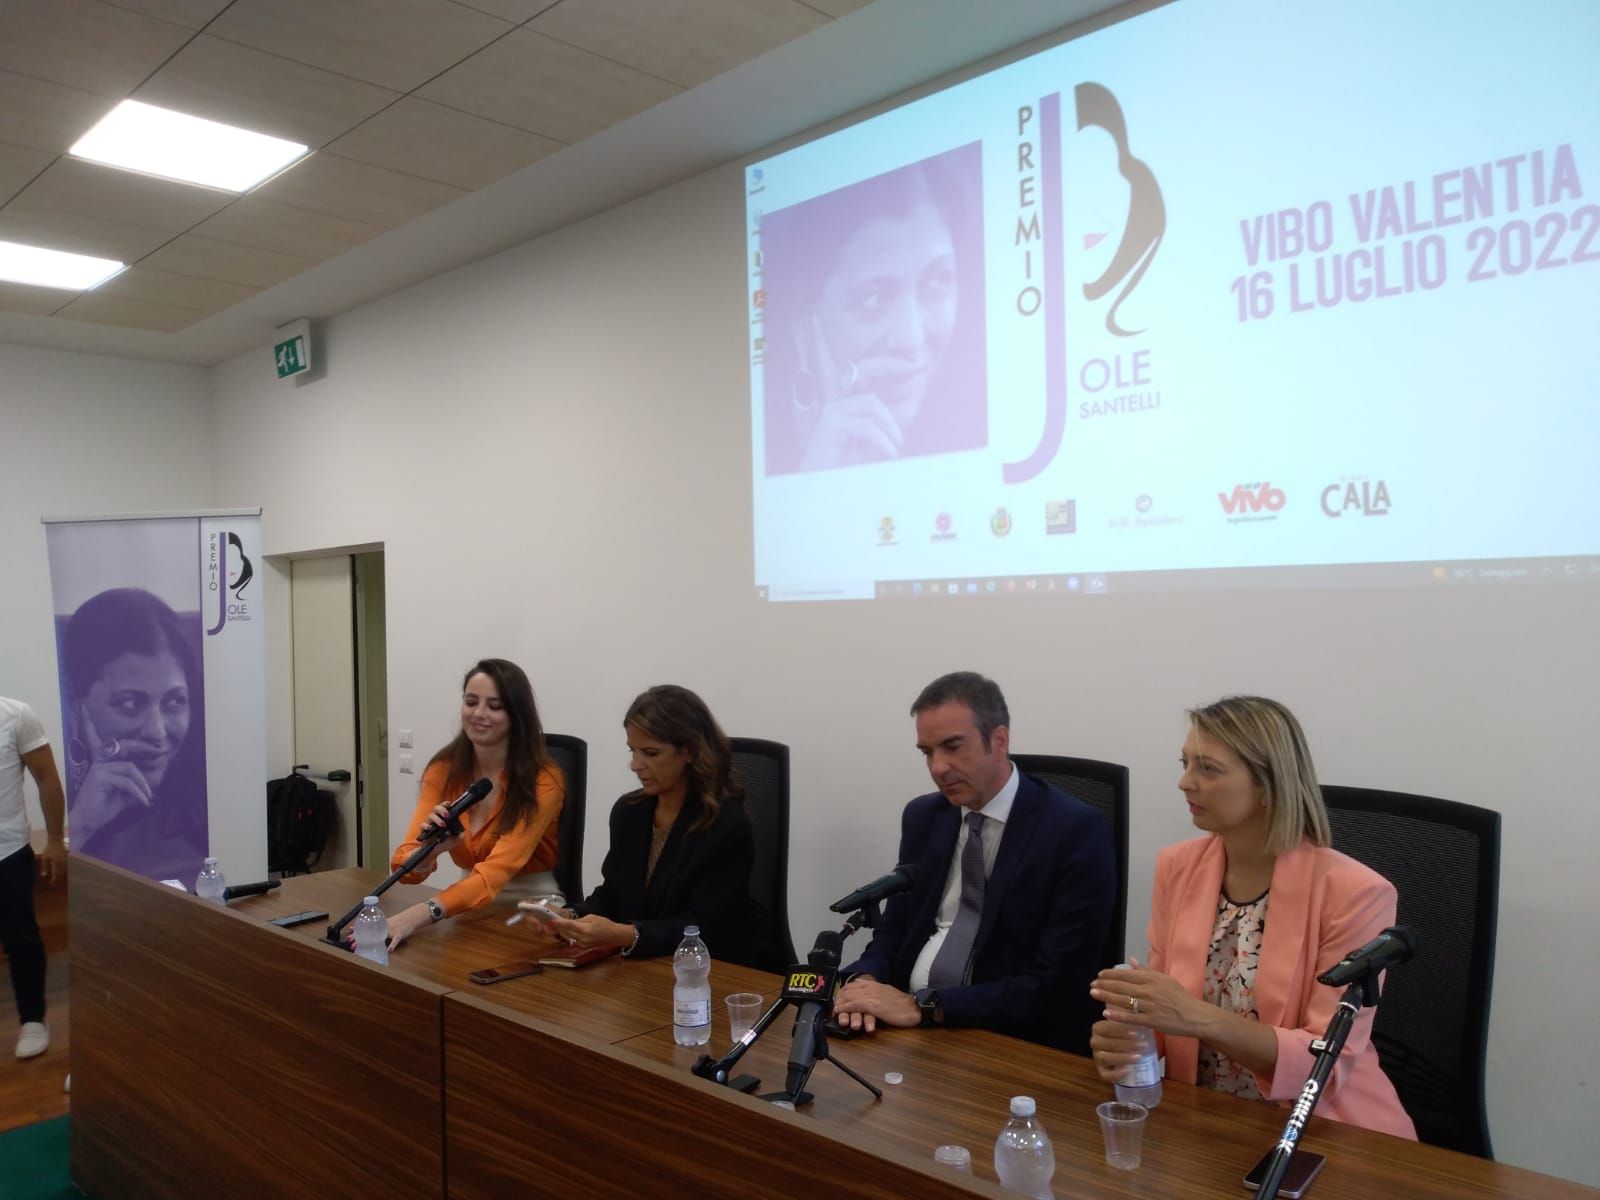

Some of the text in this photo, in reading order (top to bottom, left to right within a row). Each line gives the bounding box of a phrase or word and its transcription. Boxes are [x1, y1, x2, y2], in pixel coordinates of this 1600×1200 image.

[1015, 106, 1042, 316] PREMIO
[1240, 143, 1583, 267] VIBO VALENTIA
[1230, 204, 1600, 323] 16 LUGLIO 2022
[1079, 391, 1161, 420] SANTELLI
[1321, 480, 1392, 518] CALA
[209, 533, 218, 591] PREMIO
[789, 973, 817, 988] RTC
